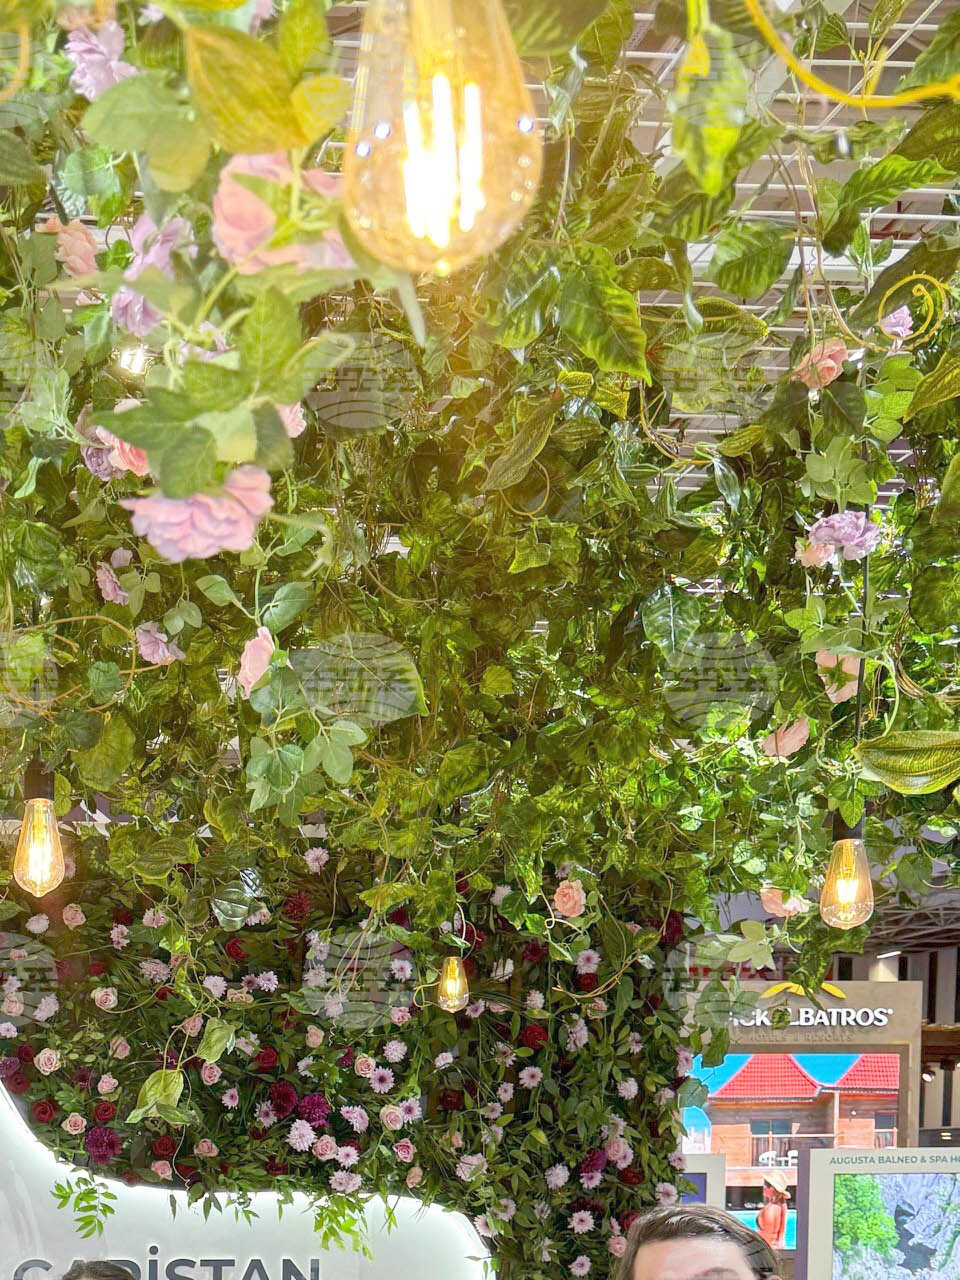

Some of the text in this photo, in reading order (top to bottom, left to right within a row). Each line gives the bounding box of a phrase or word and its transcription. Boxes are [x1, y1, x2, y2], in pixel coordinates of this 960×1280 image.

[830, 1156, 875, 1165] AUGUSTA
[878, 1155, 918, 1164] BALNEO
[920, 1155, 927, 1164] &
[929, 1155, 949, 1164] SPA
